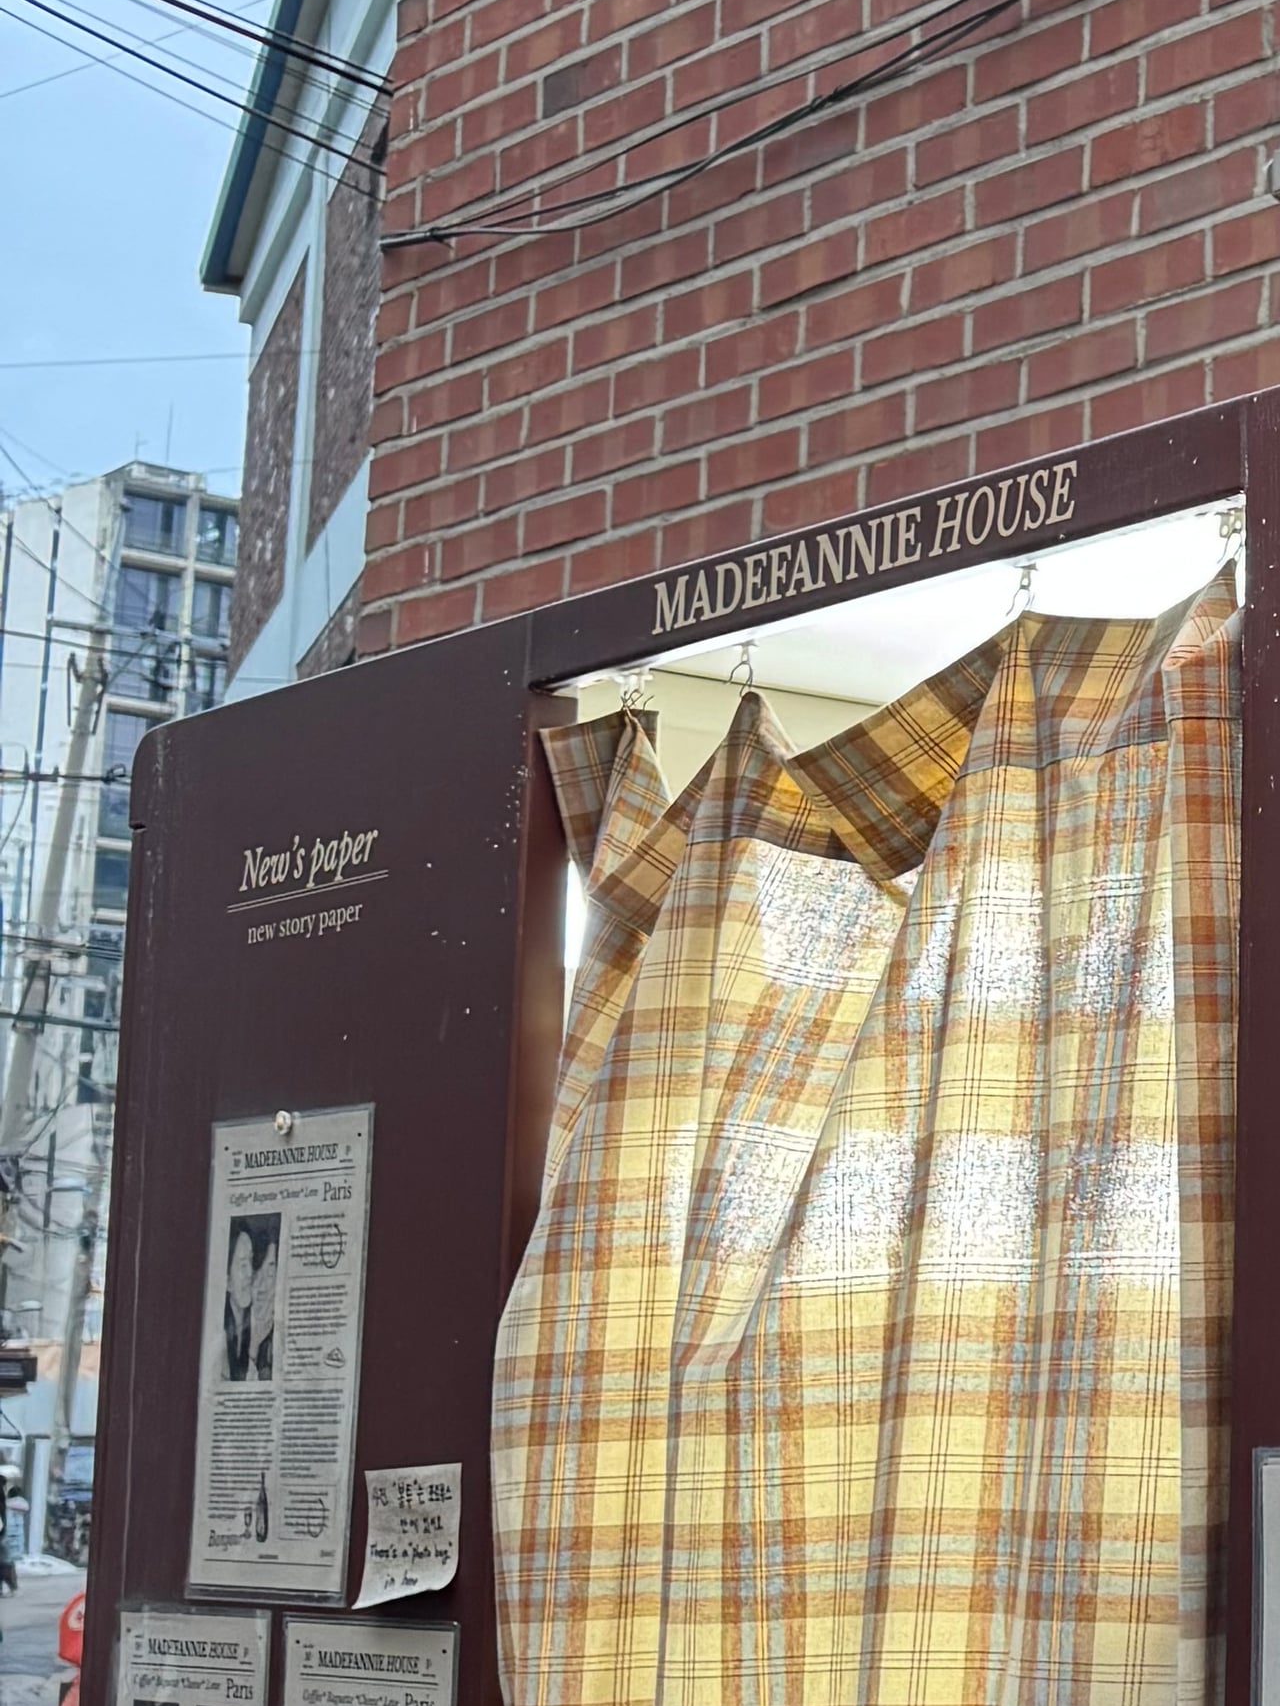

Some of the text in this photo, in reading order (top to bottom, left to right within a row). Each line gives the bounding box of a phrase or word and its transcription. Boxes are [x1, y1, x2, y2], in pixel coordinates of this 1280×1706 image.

[651, 460, 1078, 636] MADEFANNIE HOUSE
[238, 829, 378, 892] New's paper
[248, 904, 363, 944] new story paper
[322, 1179, 352, 1201] Paris
[386, 1654, 420, 1674] HOUSE
[225, 1677, 254, 1700] Paris
